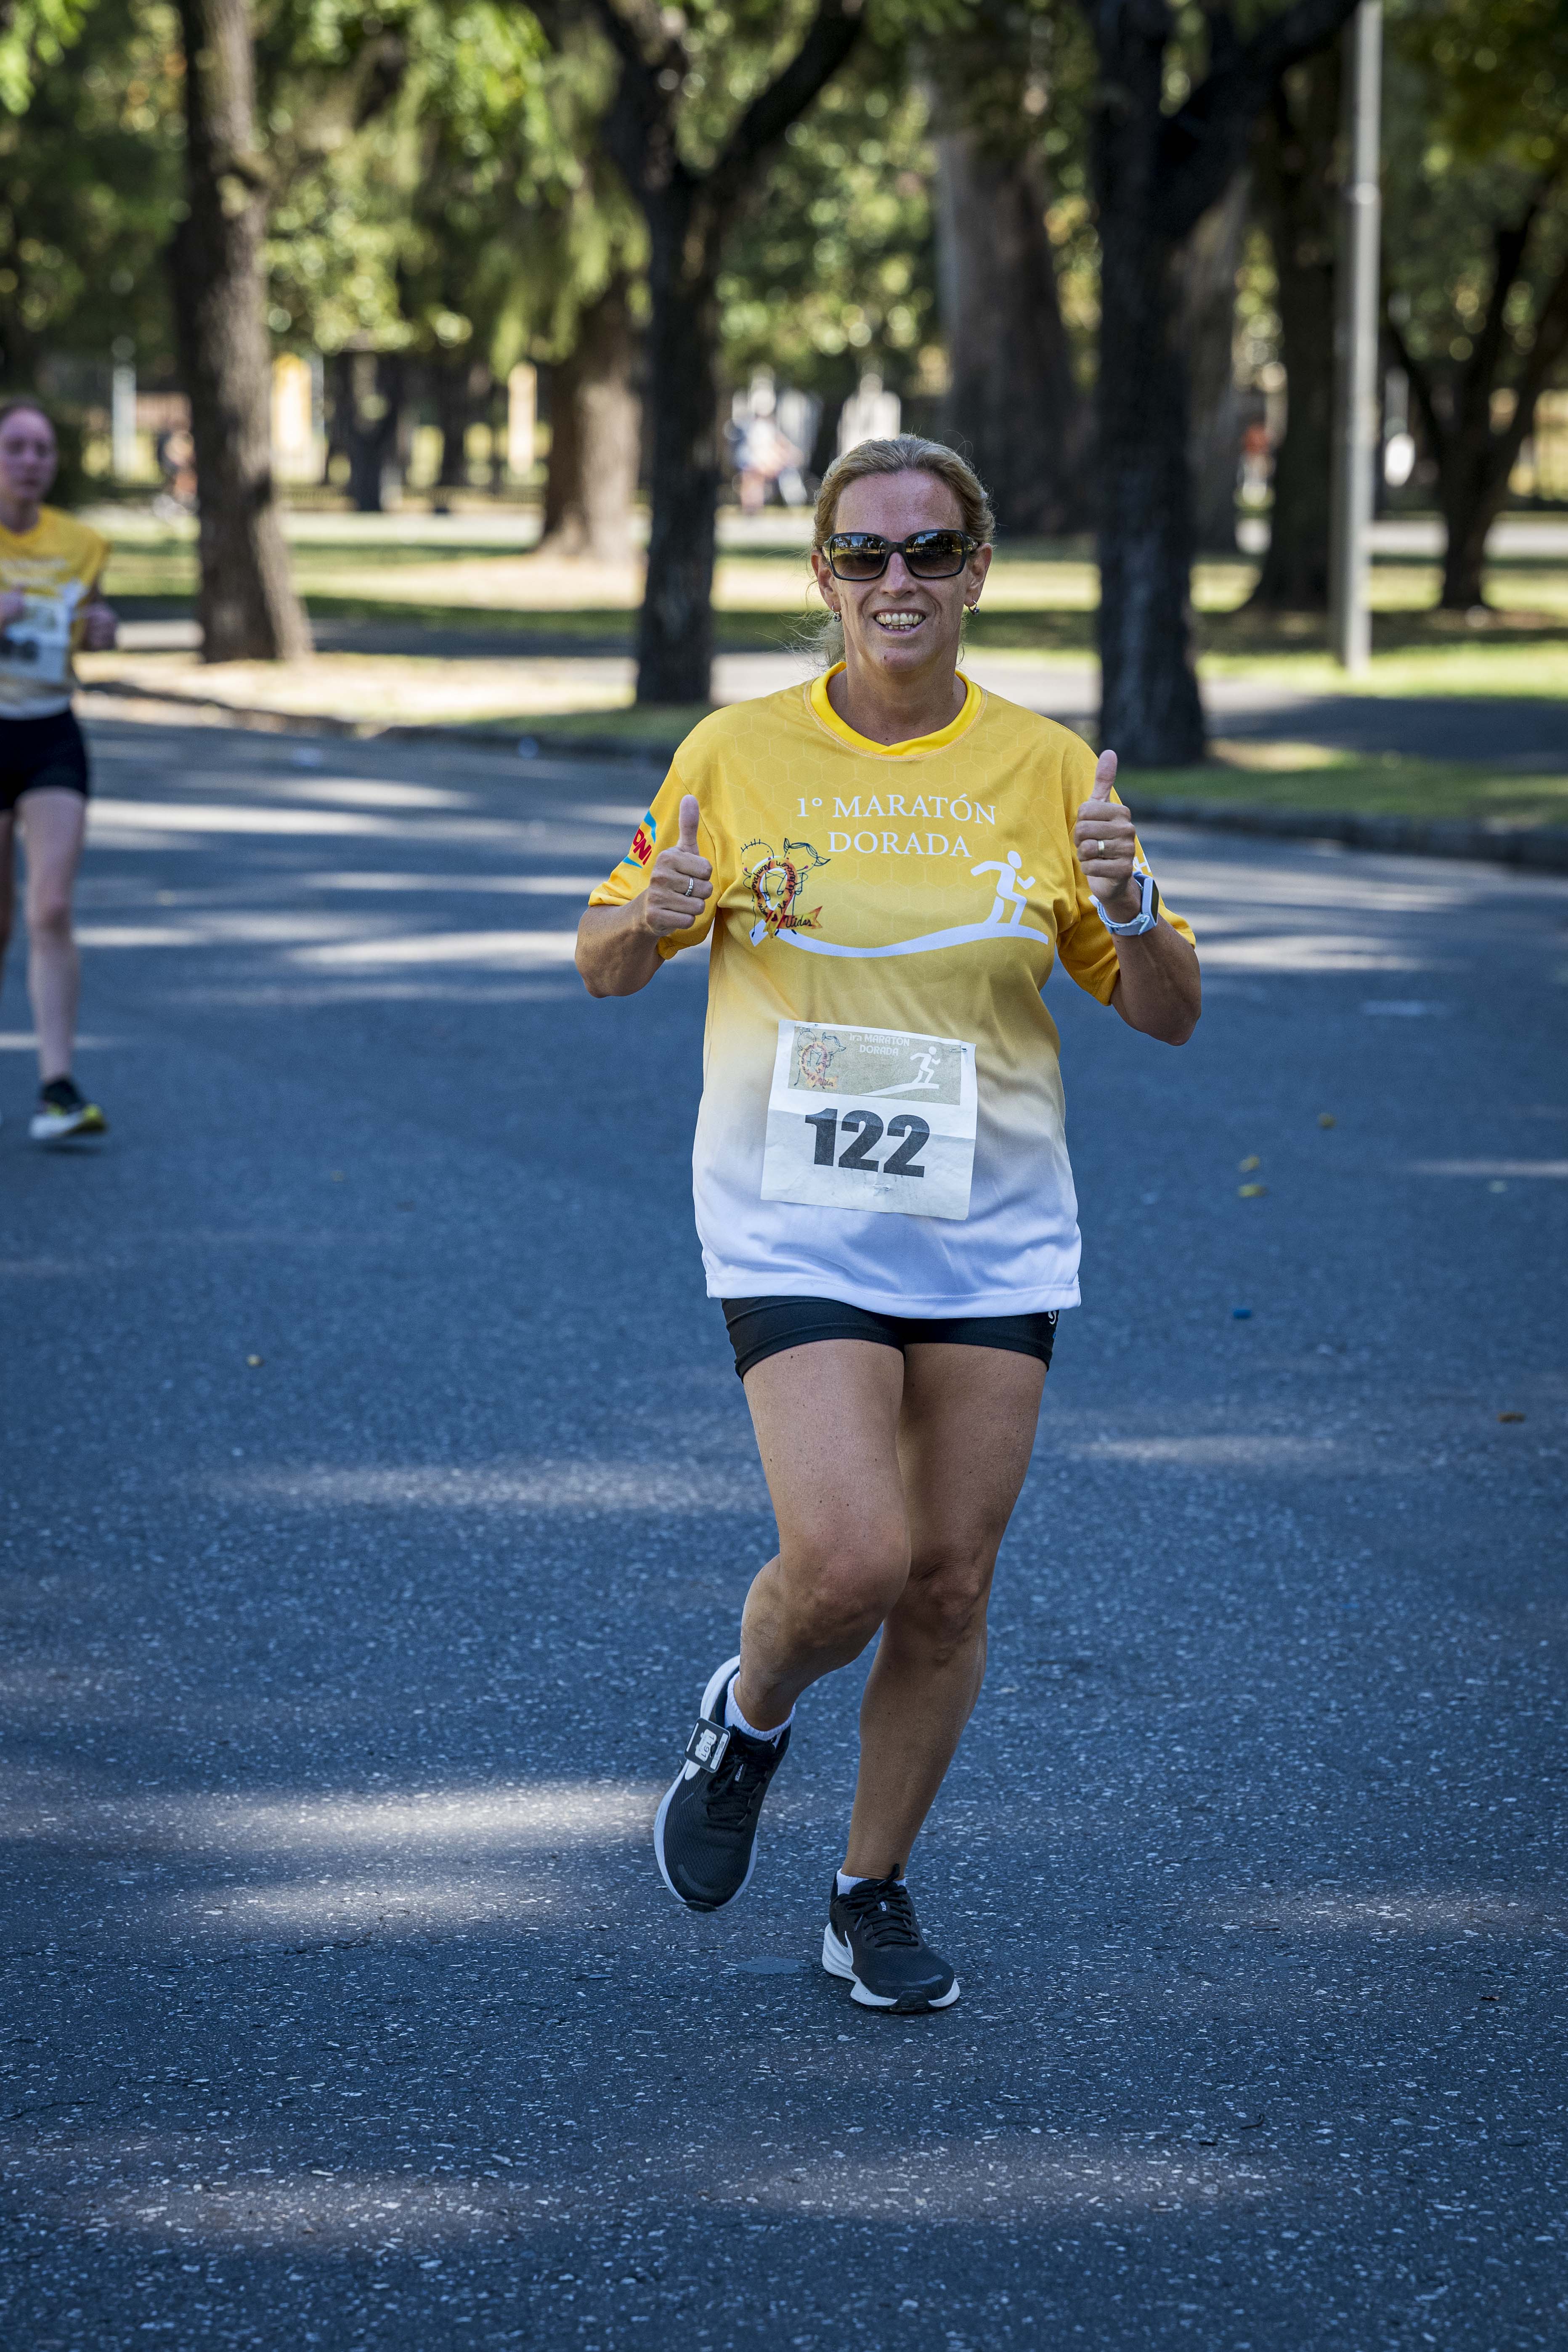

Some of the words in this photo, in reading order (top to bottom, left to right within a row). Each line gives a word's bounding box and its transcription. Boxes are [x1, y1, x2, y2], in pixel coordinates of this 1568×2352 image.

[833, 793, 996, 825] MARATÓN
[827, 832, 972, 858] DORADA
[859, 1045, 899, 1056] DORADA
[804, 1108, 930, 1178] 122
